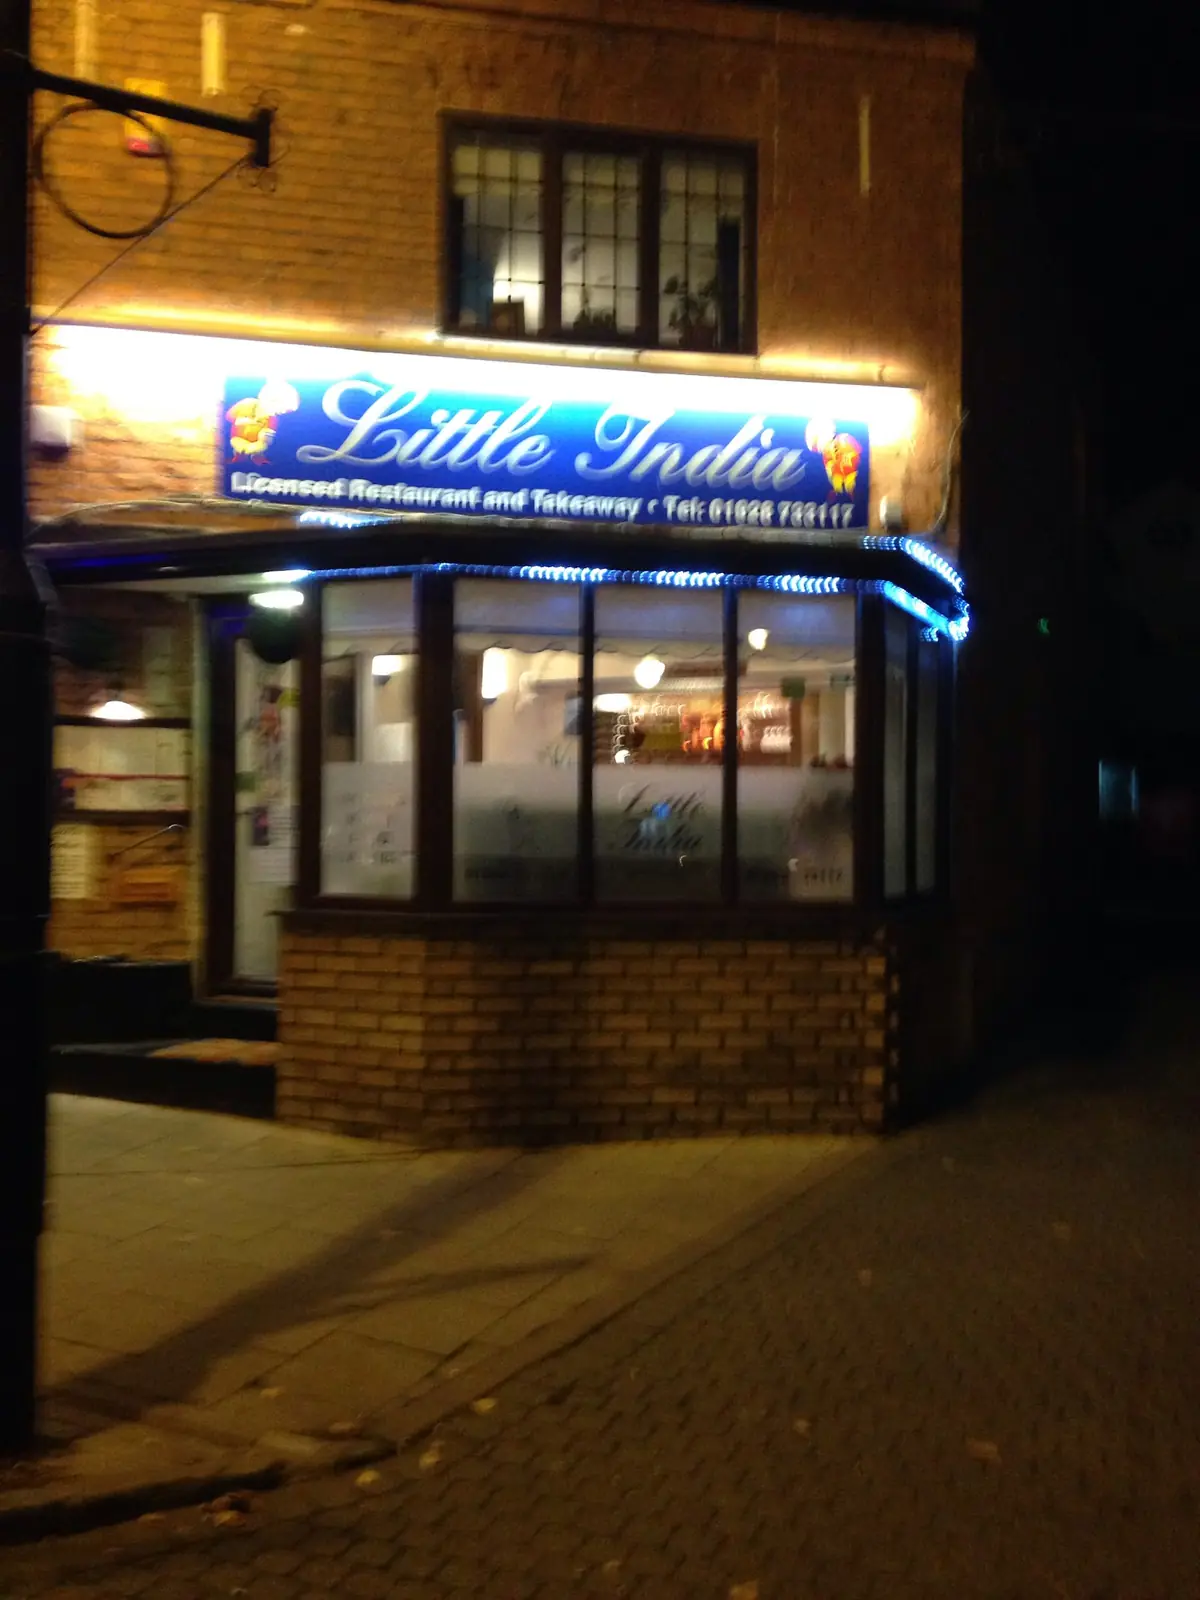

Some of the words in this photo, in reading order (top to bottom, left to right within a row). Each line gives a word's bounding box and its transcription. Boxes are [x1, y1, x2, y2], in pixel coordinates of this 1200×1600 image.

[296, 377, 554, 475] Little
[574, 401, 806, 489] India
[231, 471, 348, 499] Licensed
[348, 478, 482, 510] Restaurant
[483, 487, 529, 512] and
[530, 488, 643, 523] Takeaway
